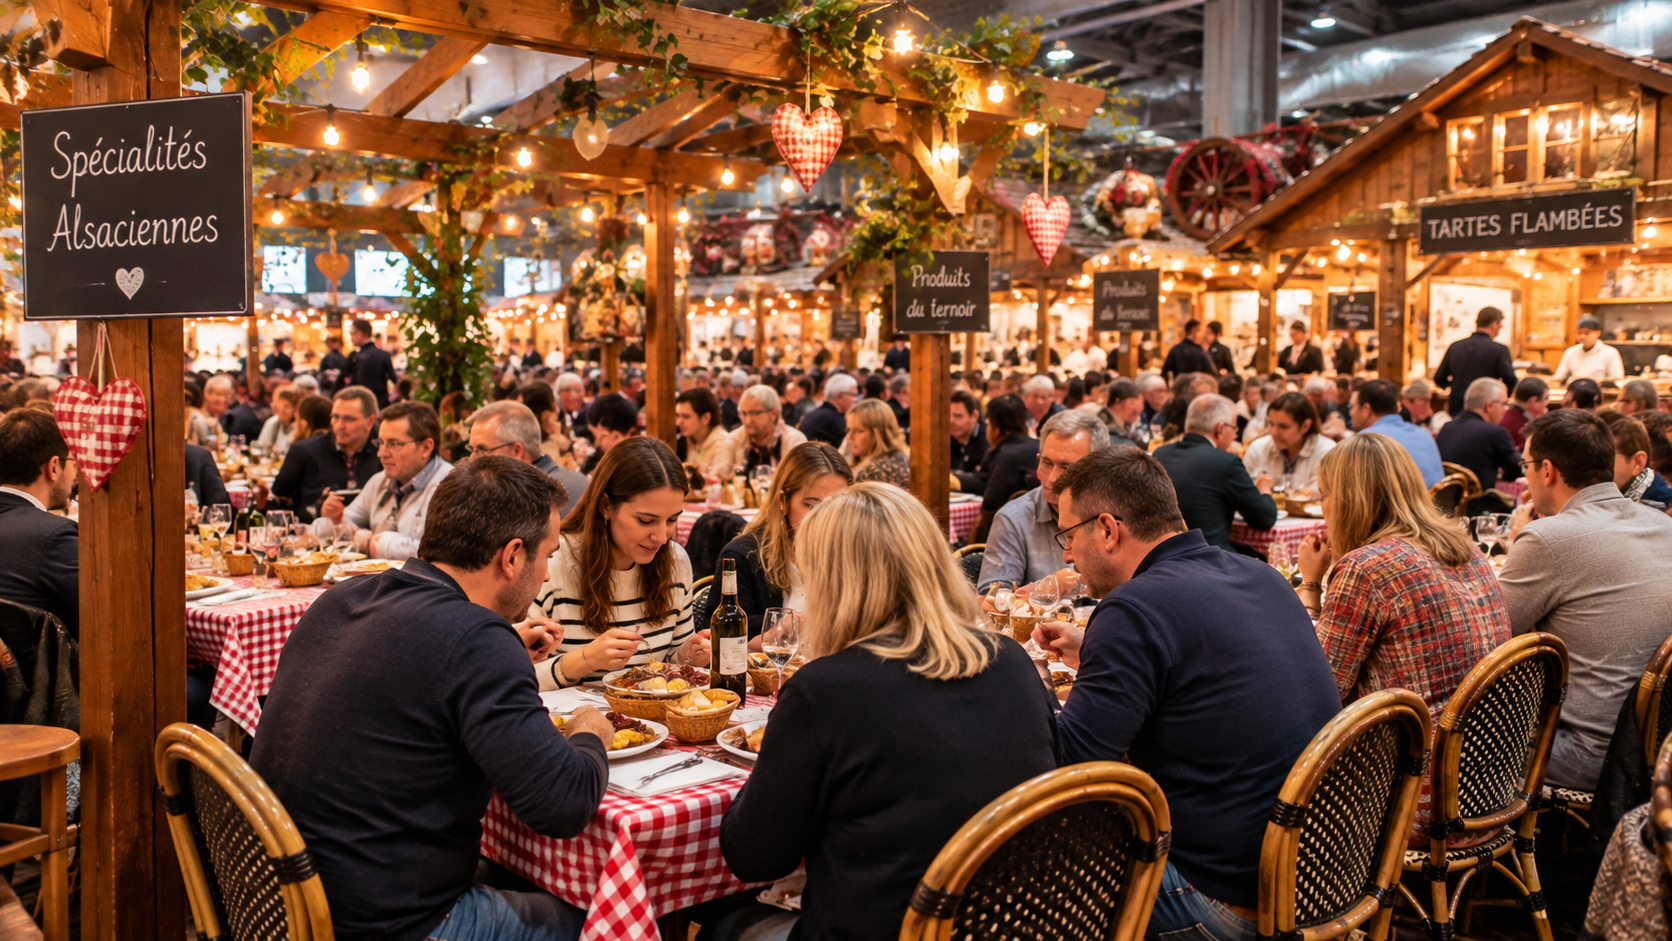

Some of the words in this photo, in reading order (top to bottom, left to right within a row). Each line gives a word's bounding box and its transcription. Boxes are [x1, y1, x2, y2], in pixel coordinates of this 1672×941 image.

[51, 124, 207, 198] Spécialités
[47, 203, 219, 252] Alsaciennes
[1427, 214, 1501, 240] TARTES
[1510, 202, 1623, 235] FLAMBÉES
[906, 298, 925, 318] du
